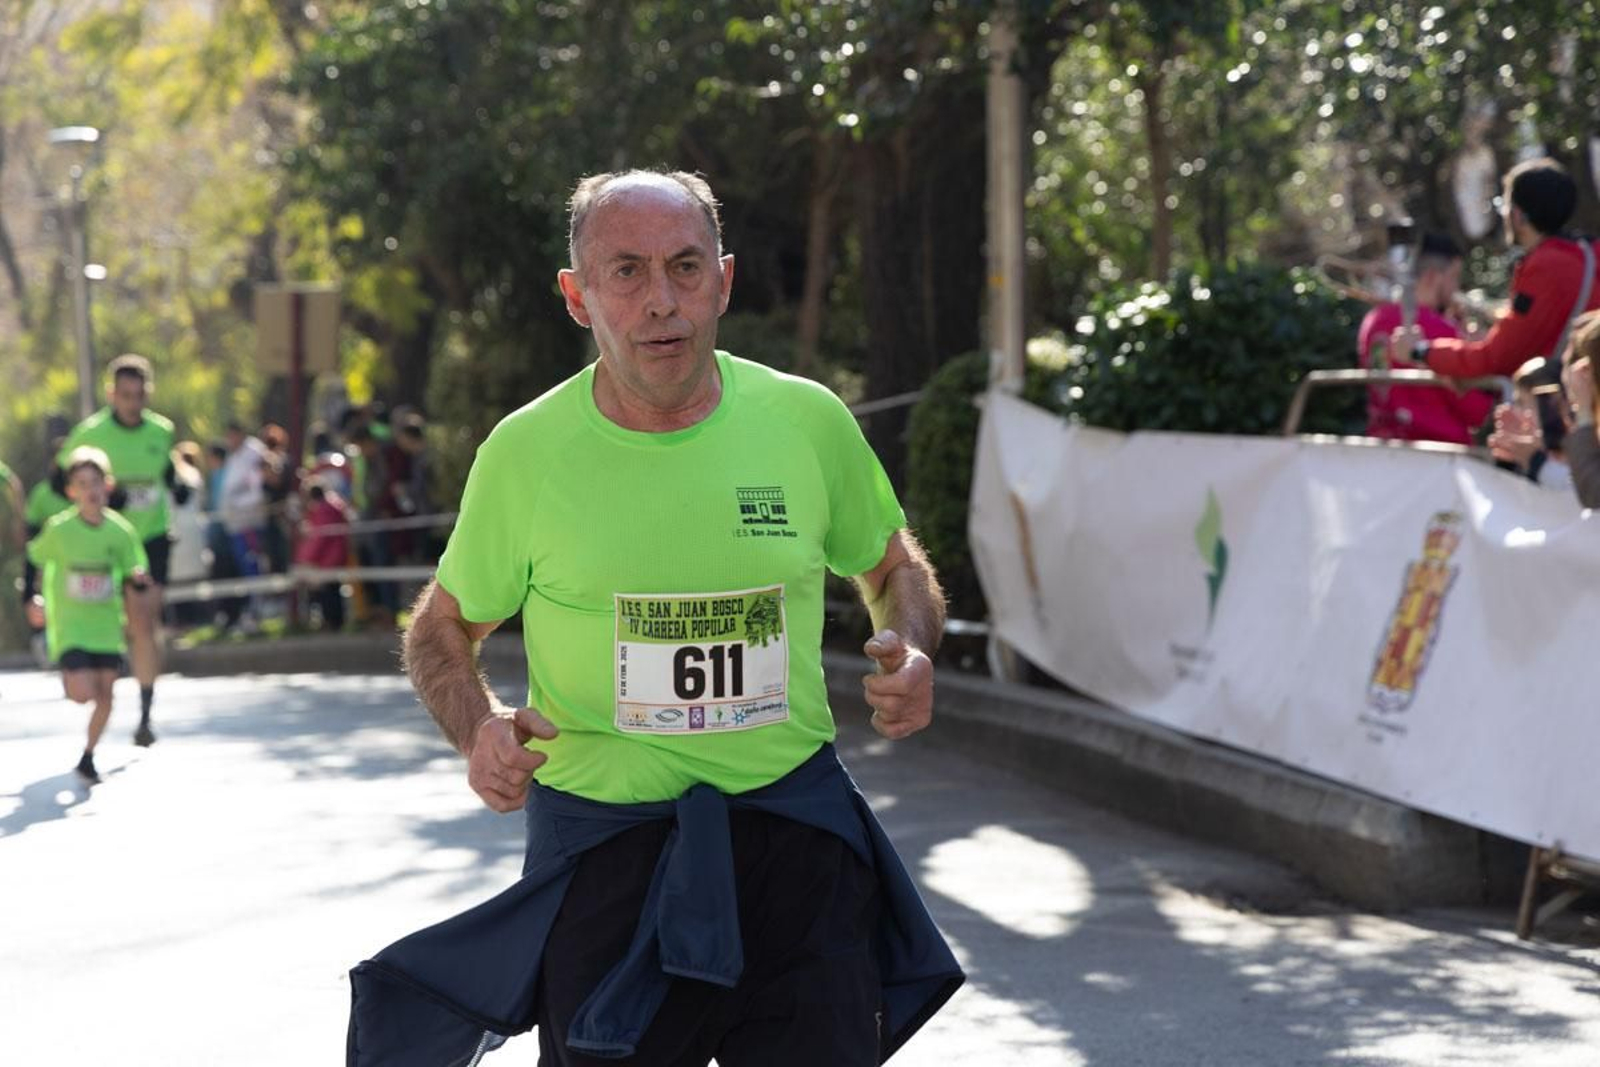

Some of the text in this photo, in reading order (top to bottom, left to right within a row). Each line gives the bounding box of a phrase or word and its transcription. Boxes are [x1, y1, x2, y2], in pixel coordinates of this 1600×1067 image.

[648, 602, 671, 618] SAN
[676, 601, 707, 618] JUAN
[711, 598, 744, 616] BOSCO
[629, 617, 737, 639] IV CARRERA POPULAR
[673, 643, 744, 700] 611
